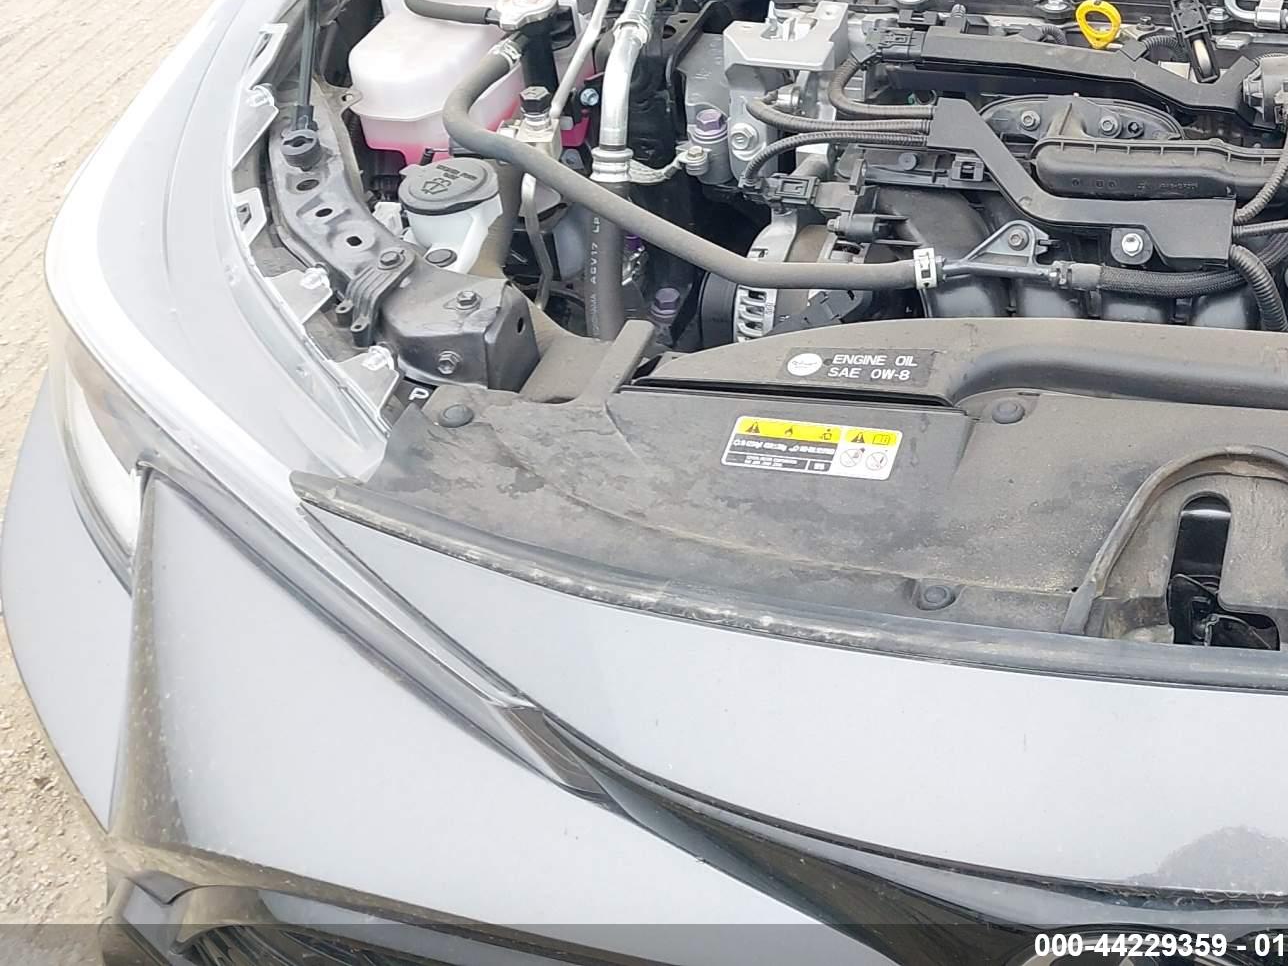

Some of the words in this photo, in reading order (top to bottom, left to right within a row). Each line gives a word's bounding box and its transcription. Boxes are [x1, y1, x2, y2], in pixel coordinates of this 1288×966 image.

[831, 354, 888, 366] ENGINE
[894, 355, 918, 367] OIL
[827, 367, 862, 379] SAE
[870, 368, 911, 381] 0W-8
[408, 387, 429, 400] P
